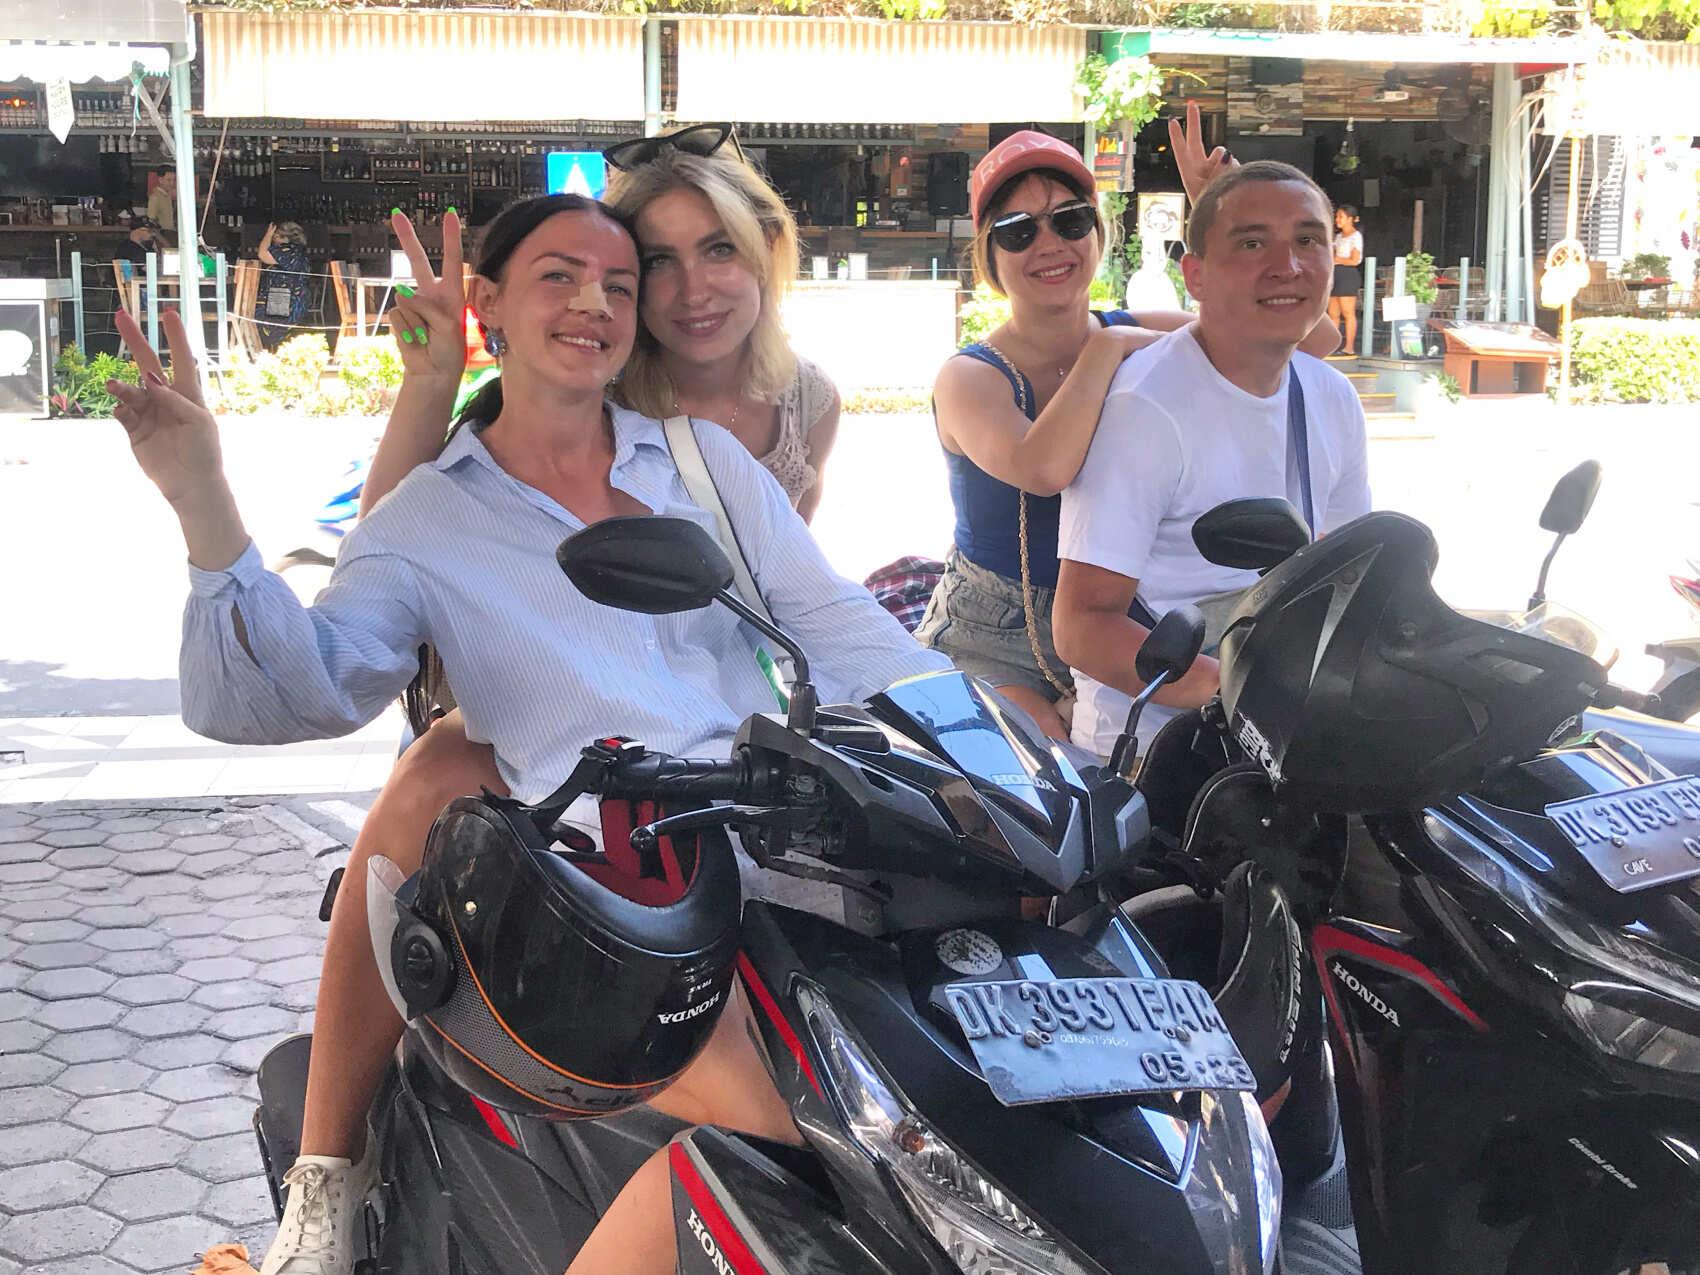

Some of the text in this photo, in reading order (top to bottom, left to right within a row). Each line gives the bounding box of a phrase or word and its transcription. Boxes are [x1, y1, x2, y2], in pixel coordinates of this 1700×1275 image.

[991, 774, 1058, 792] HONDA
[657, 991, 720, 1024] HONDA
[945, 988, 1021, 1040] DK
[1018, 980, 1142, 1033] 3931
[1333, 961, 1400, 1027] HONDA
[686, 1207, 736, 1275] HON
